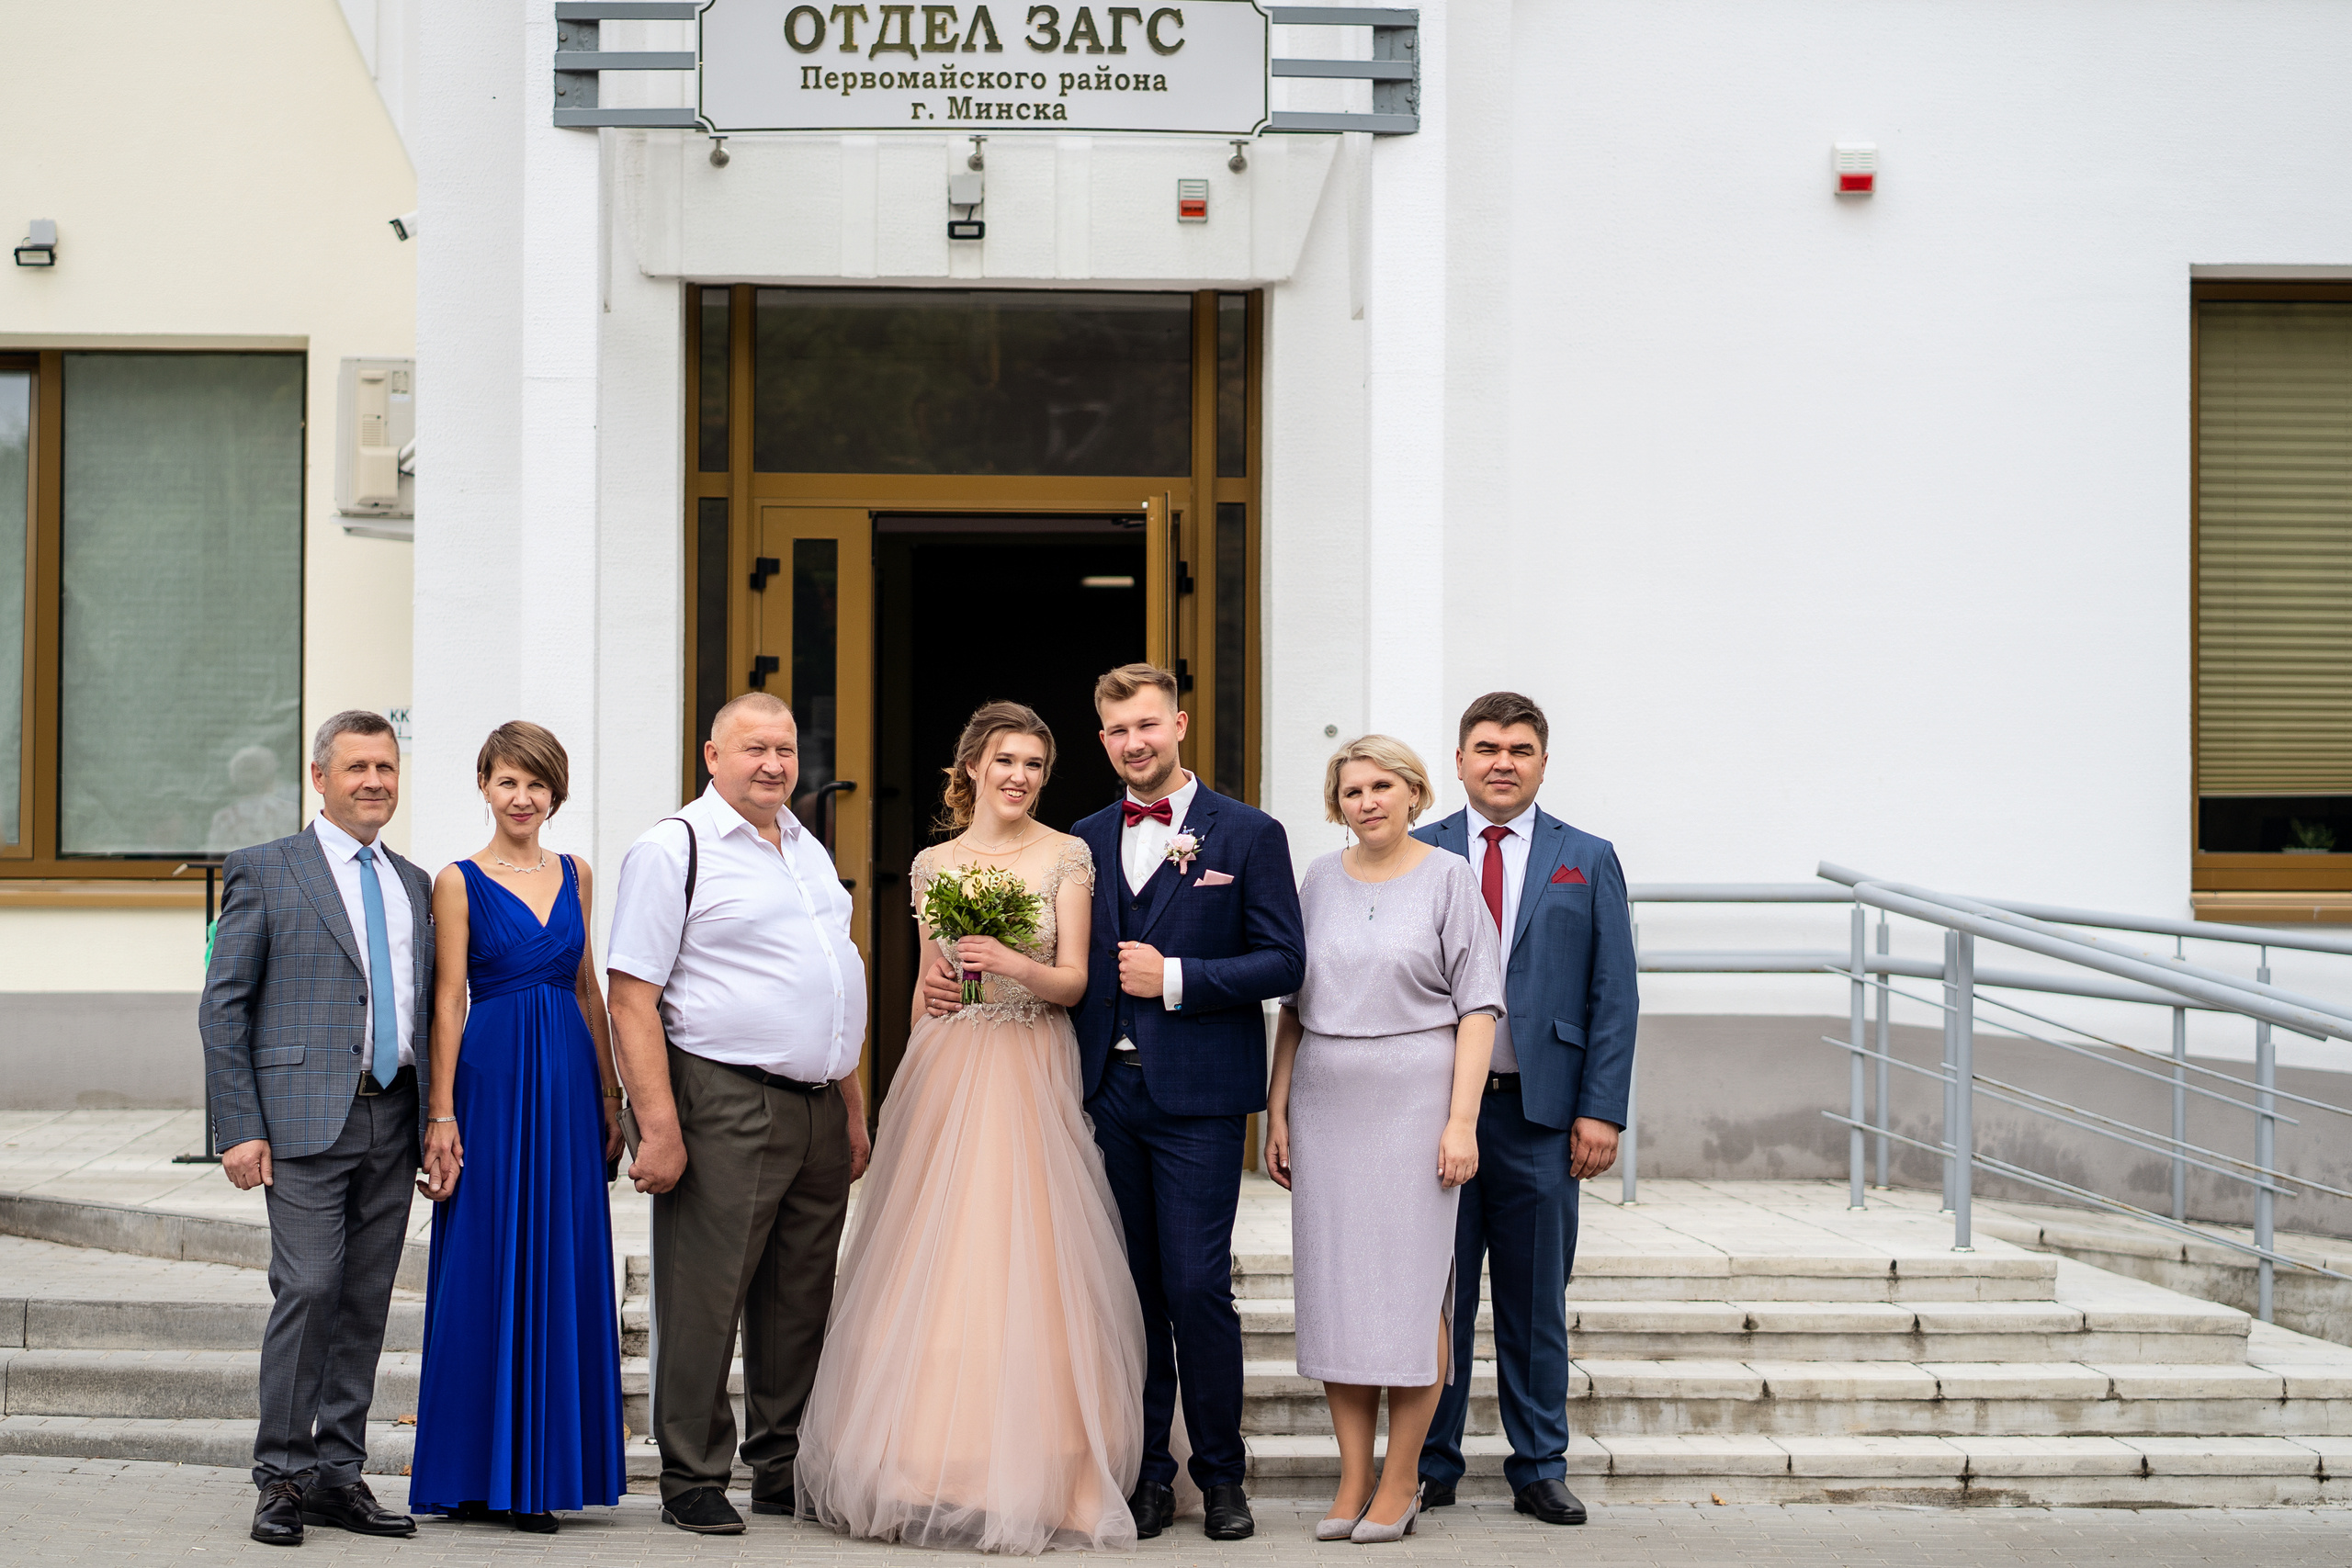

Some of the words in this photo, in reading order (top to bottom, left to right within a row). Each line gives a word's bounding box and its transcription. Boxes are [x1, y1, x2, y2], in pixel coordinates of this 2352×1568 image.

[784, 3, 1003, 61] ОТДЕЛ
[1024, 5, 1185, 56] ЗАГС
[800, 63, 1047, 96] Первомайского
[1058, 64, 1168, 96] района
[910, 102, 935, 120] г.
[947, 95, 1068, 120] Минска
